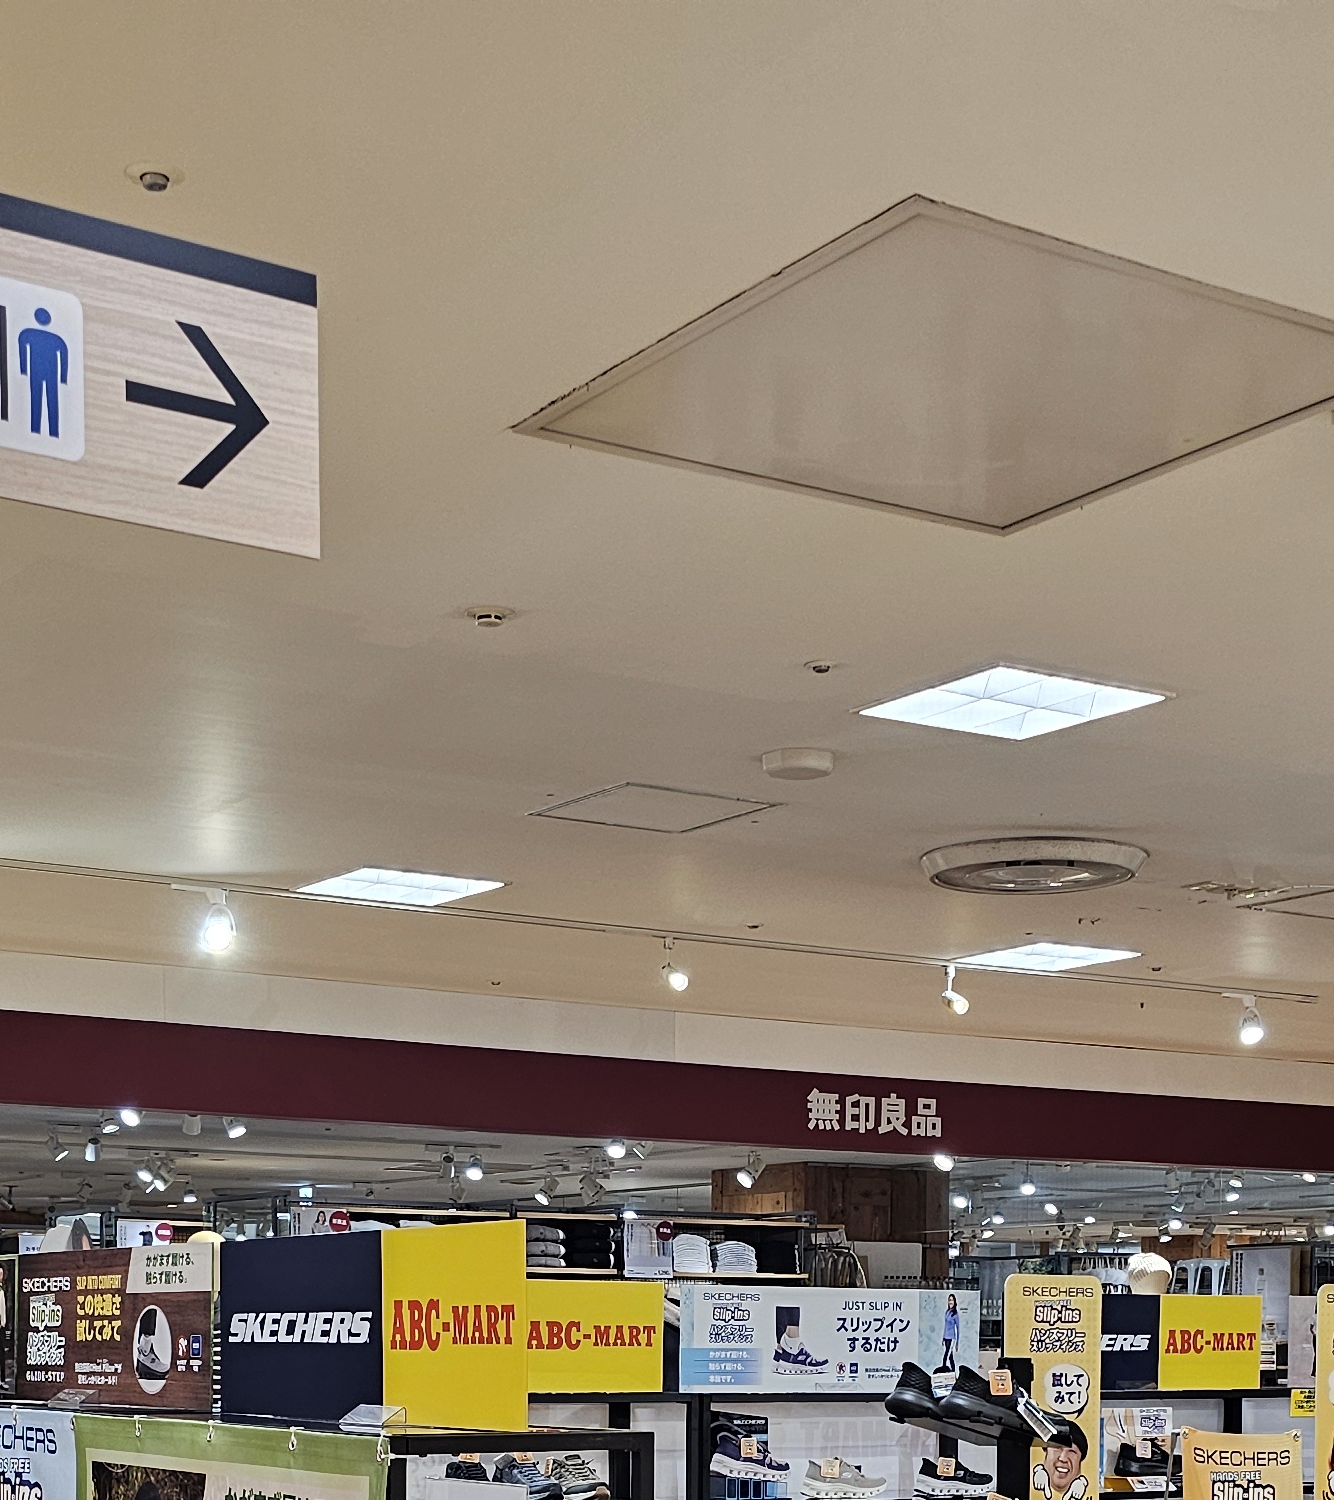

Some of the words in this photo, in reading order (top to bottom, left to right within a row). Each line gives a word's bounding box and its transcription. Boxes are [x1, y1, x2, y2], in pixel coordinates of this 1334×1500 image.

[806, 1087, 942, 1138] 無印良品
[145, 1252, 194, 1267] かがまず履ける、
[22, 1277, 71, 1292] SKECHERS
[1022, 1286, 1094, 1298] SKECHERS
[76, 1294, 122, 1316] この快適さ
[703, 1292, 761, 1301] SKECHERS
[842, 1301, 867, 1312] JUST
[869, 1301, 889, 1312] SLIP
[892, 1301, 903, 1312] IN
[1034, 1305, 1081, 1325] Slip-ins
[30, 1302, 62, 1329] Slip-ins
[713, 1306, 750, 1325] Slip-ins
[76, 1319, 122, 1342] 試してみて
[228, 1311, 372, 1344] SKECHERS
[390, 1299, 516, 1352] ABC-MART
[709, 1324, 754, 1335] ハンズフリー
[836, 1317, 911, 1334] スリップイン
[27, 1331, 65, 1350] ハンズフリー
[527, 1320, 657, 1351] ABC-MART
[709, 1334, 754, 1344] スリップインズ
[1030, 1328, 1086, 1342] ハンズフリー
[1165, 1329, 1257, 1354] ABC-MART
[847, 1336, 900, 1353] するだけ
[1030, 1340, 1085, 1353] スリップインズ
[27, 1349, 65, 1366] スリップインズ
[25, 1370, 65, 1383] GLIDE-STEP
[1051, 1372, 1085, 1388] 試して
[1053, 1390, 1082, 1405] みて!
[10, 1458, 31, 1473] FREE
[1193, 1447, 1291, 1467] SKECHERS
[1210, 1471, 1239, 1481] HANDS
[1240, 1470, 1261, 1480] FREE
